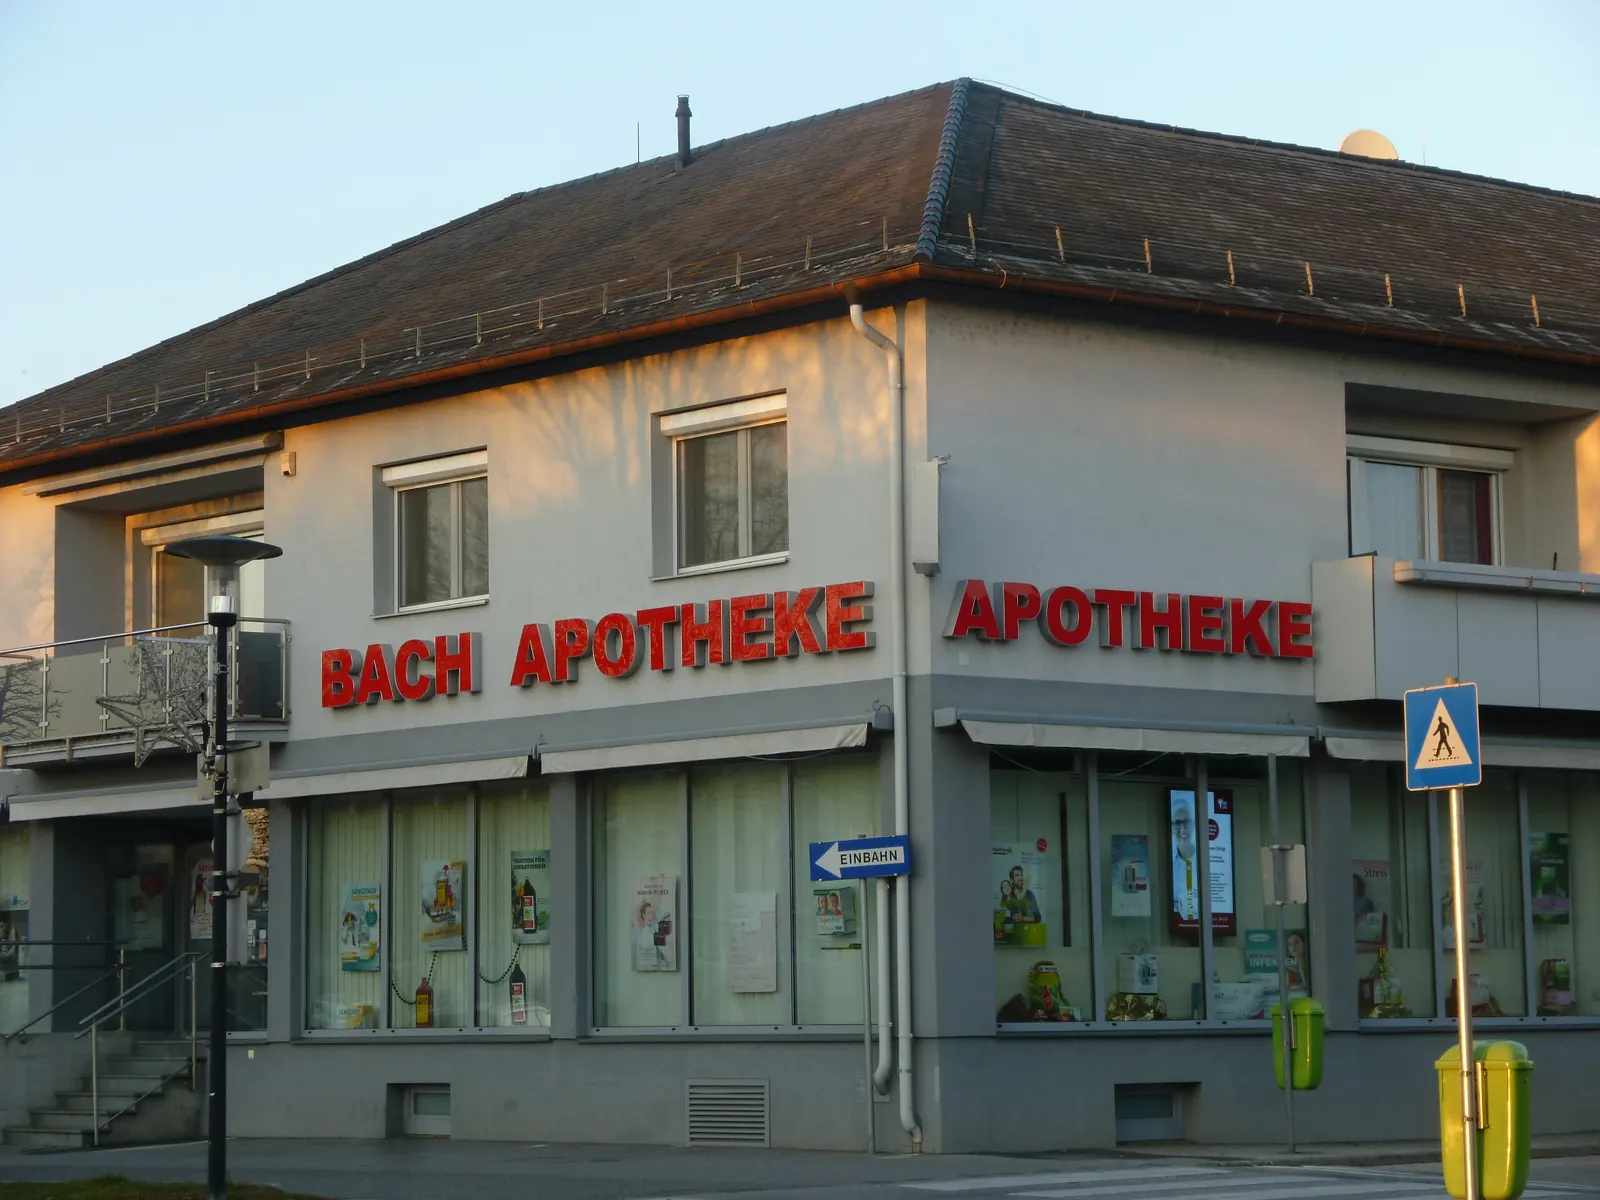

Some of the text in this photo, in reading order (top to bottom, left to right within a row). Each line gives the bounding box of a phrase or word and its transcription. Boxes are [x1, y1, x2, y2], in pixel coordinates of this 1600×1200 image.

[947, 579, 1314, 658] APOTHEKE
[321, 581, 874, 709] BACH APOTHEKE
[840, 850, 898, 865] EINBAHN
[1364, 867, 1388, 877] Stress
